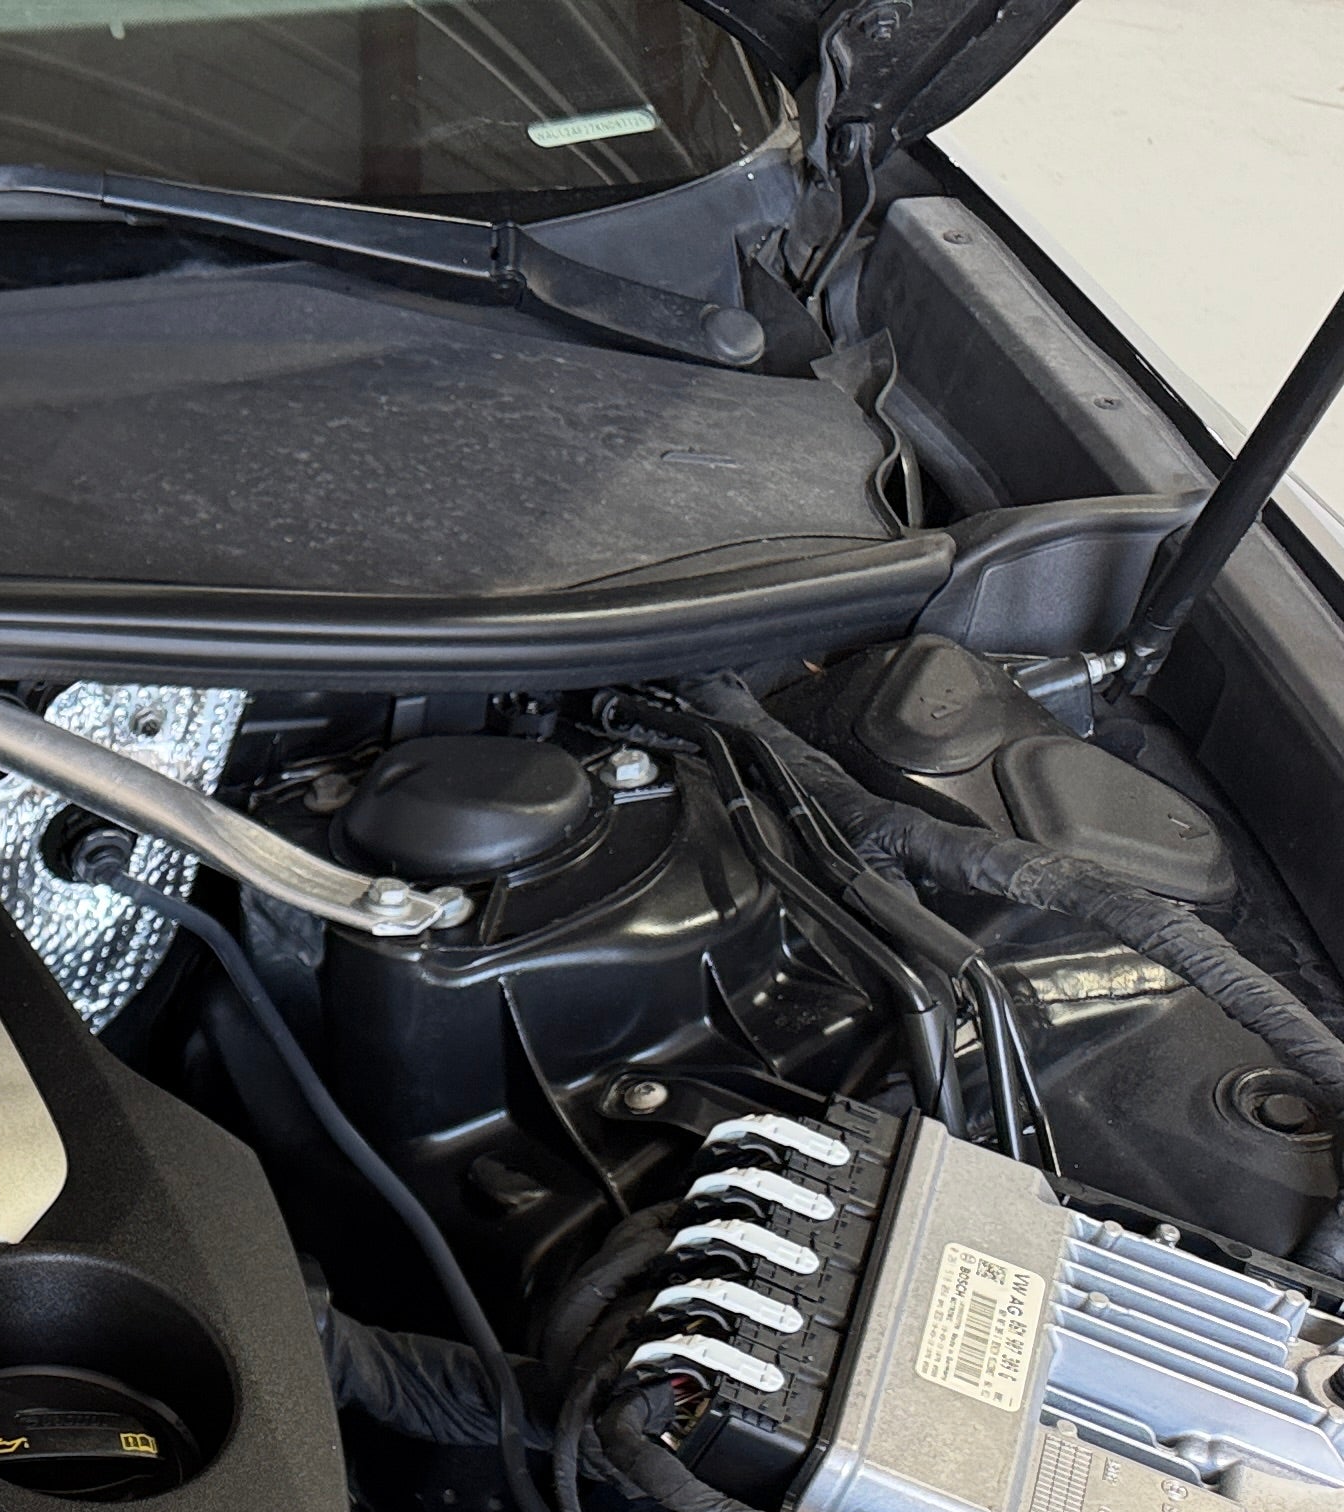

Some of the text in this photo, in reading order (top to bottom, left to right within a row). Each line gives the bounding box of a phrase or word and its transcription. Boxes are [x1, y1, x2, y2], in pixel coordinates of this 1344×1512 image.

[956, 1265, 971, 1298] BOSCH
[1011, 1272, 1031, 1297] VW
[1007, 1295, 1025, 1317] AG
